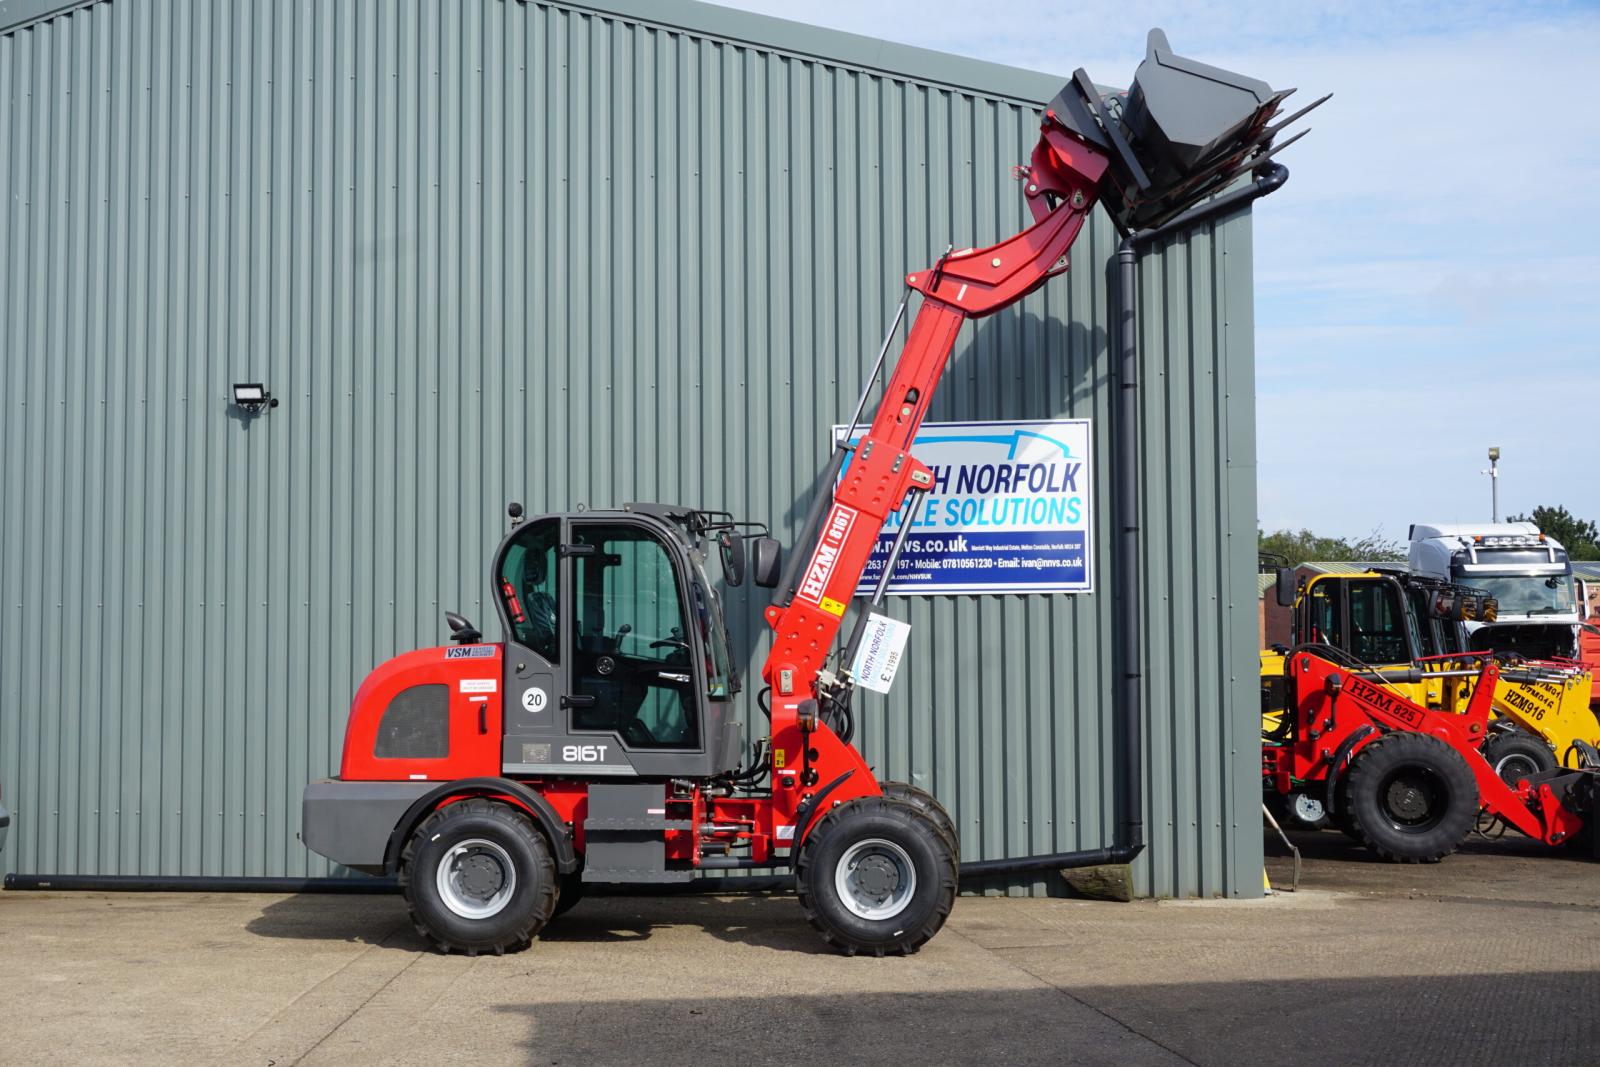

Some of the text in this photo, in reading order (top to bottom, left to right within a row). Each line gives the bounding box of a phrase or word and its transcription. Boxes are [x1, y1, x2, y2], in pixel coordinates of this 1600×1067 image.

[956, 463, 1081, 494] NORFOLK
[945, 497, 1081, 527] SOLUTIONS
[803, 543, 837, 598] HZM
[915, 559, 941, 569] Mobile:
[942, 558, 993, 569] 07810561230
[998, 557, 1021, 568] Email:
[1021, 556, 1082, 570] ivan@nnvs.co.uk
[447, 647, 472, 657] VSM
[861, 654, 876, 681] NORTH
[870, 621, 887, 655] NORFOLK
[527, 694, 542, 706] 20
[1350, 681, 1415, 722] HZM 825
[1504, 689, 1546, 721] HZM916
[562, 746, 608, 762] 816T
